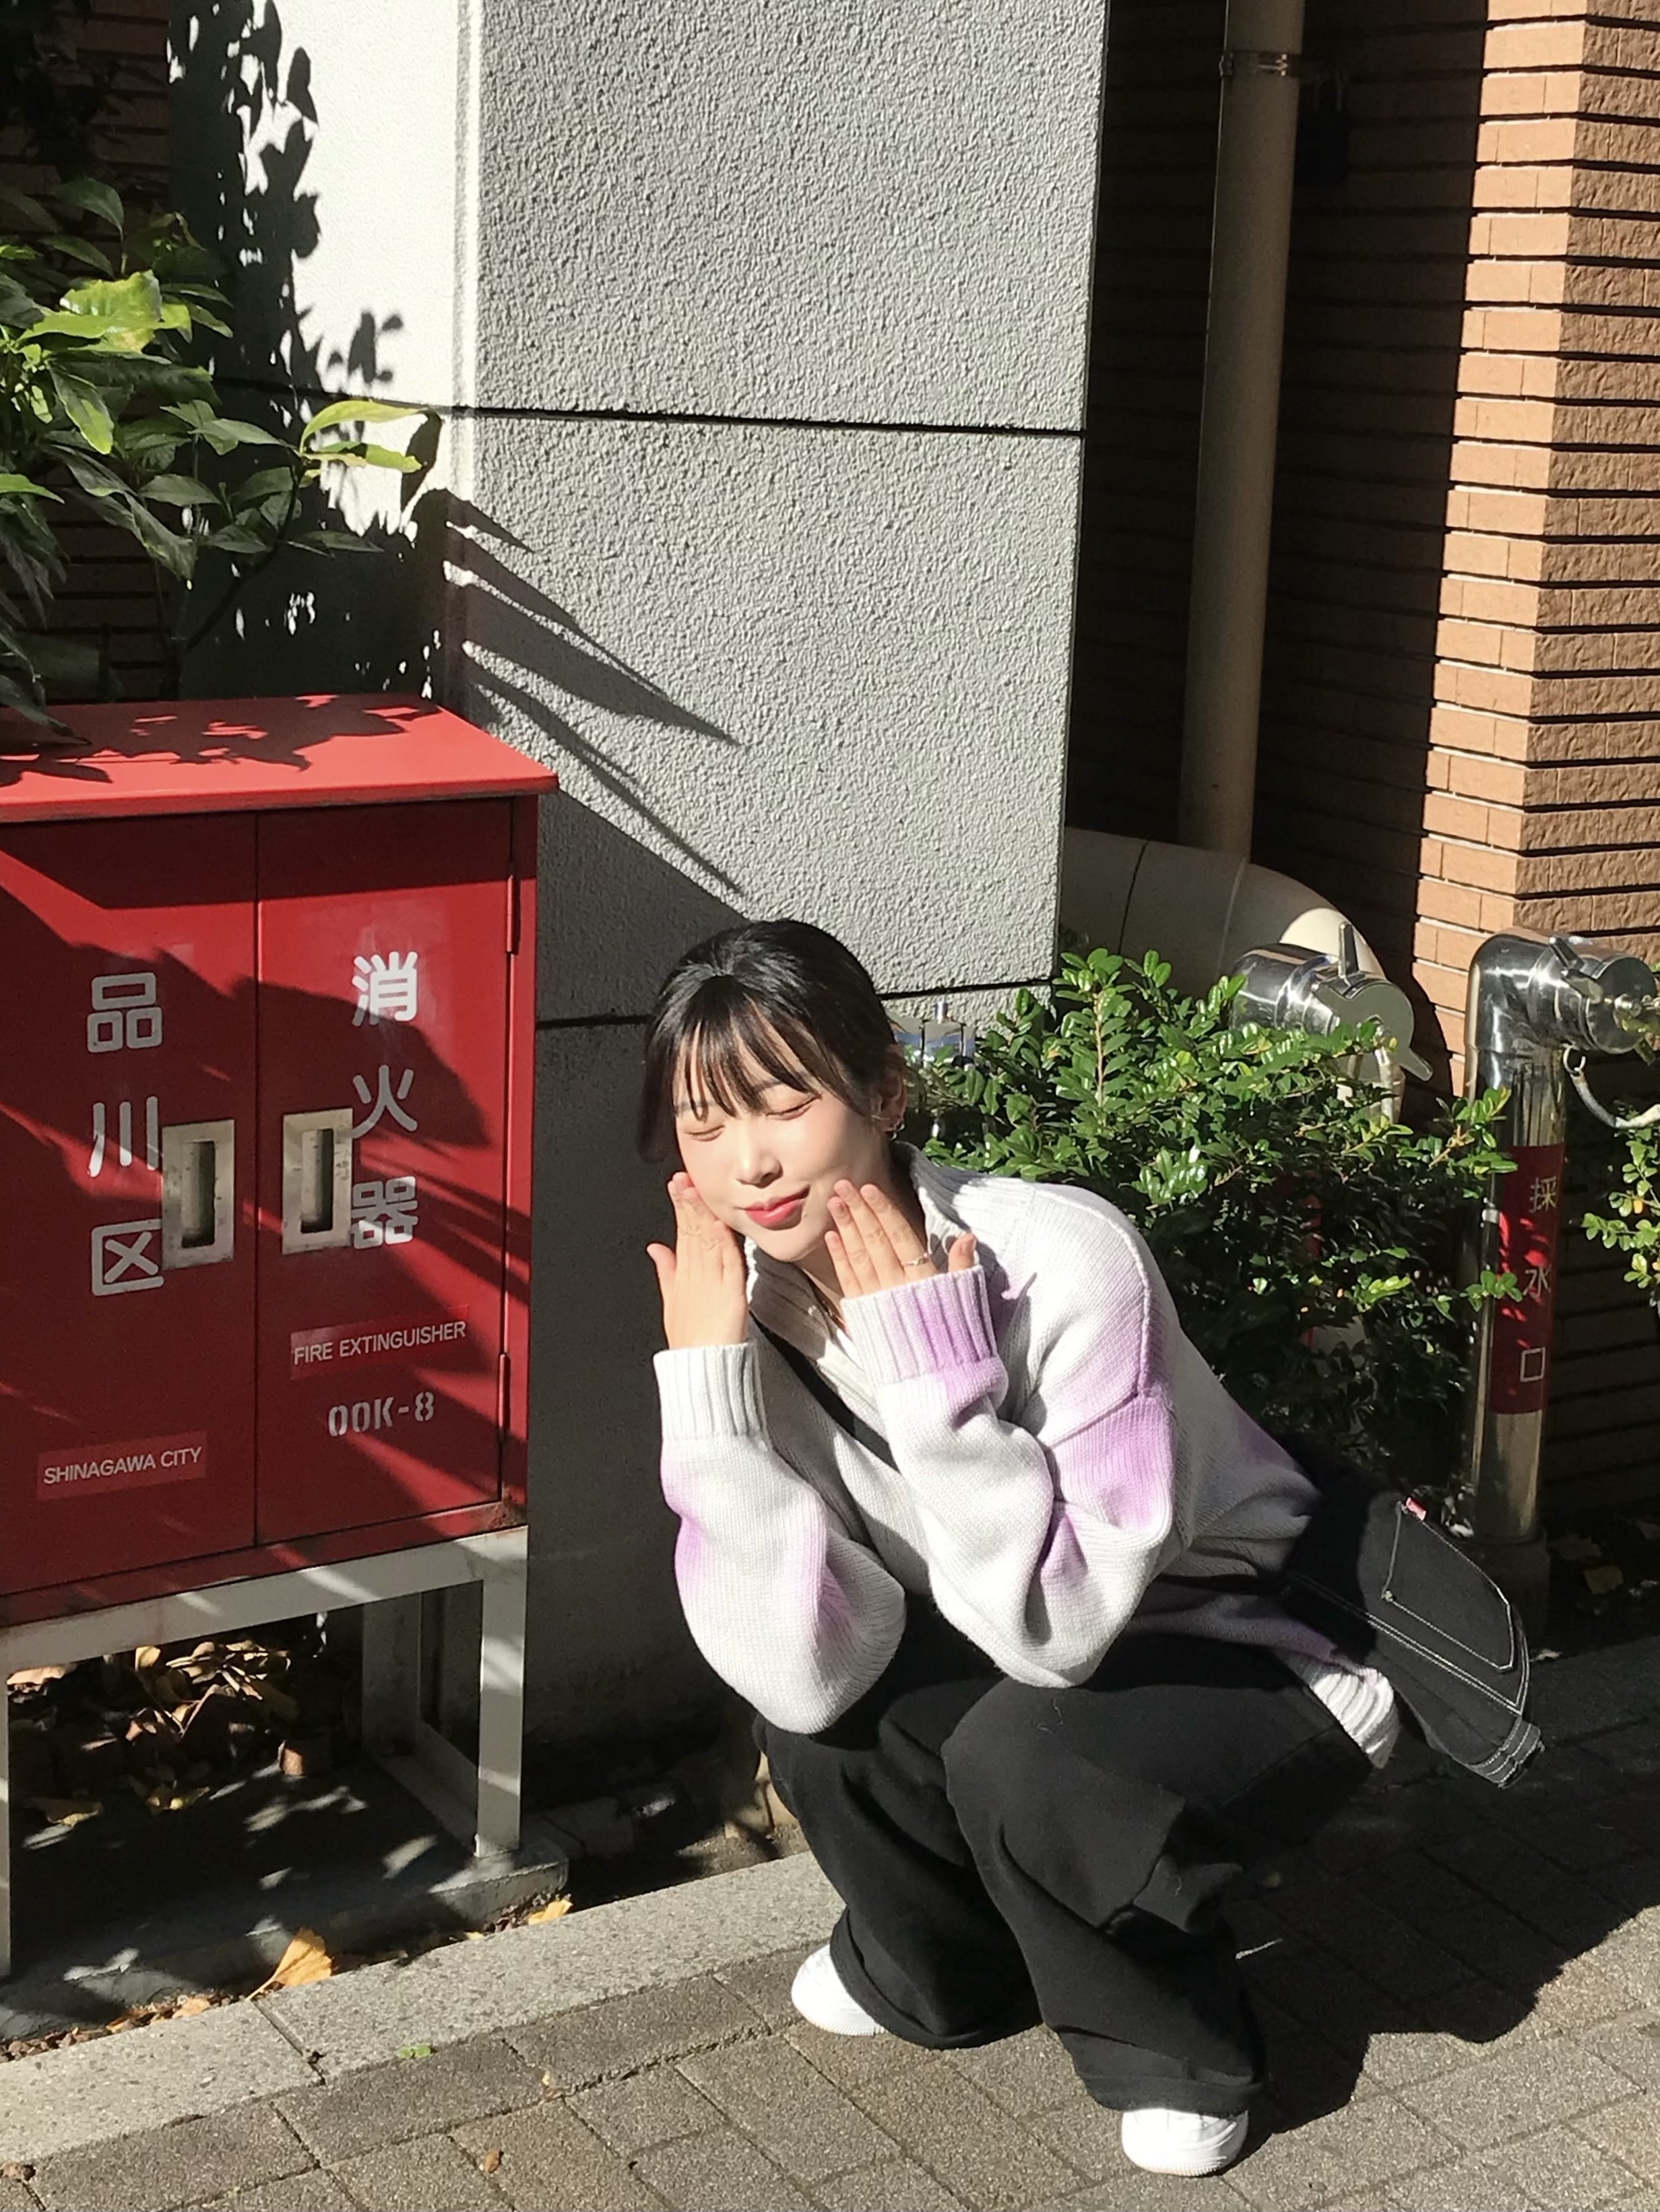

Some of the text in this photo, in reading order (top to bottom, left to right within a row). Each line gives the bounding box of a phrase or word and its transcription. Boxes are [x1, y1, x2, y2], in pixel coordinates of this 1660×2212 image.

[88, 972, 164, 1296] 品川区
[352, 951, 418, 1249] 消火器
[294, 1321, 466, 1365] FIRE EXTINGUISHER
[1521, 1176, 1558, 1383] 採水口
[43, 1447, 201, 1484] SHINAGAWA CITY
